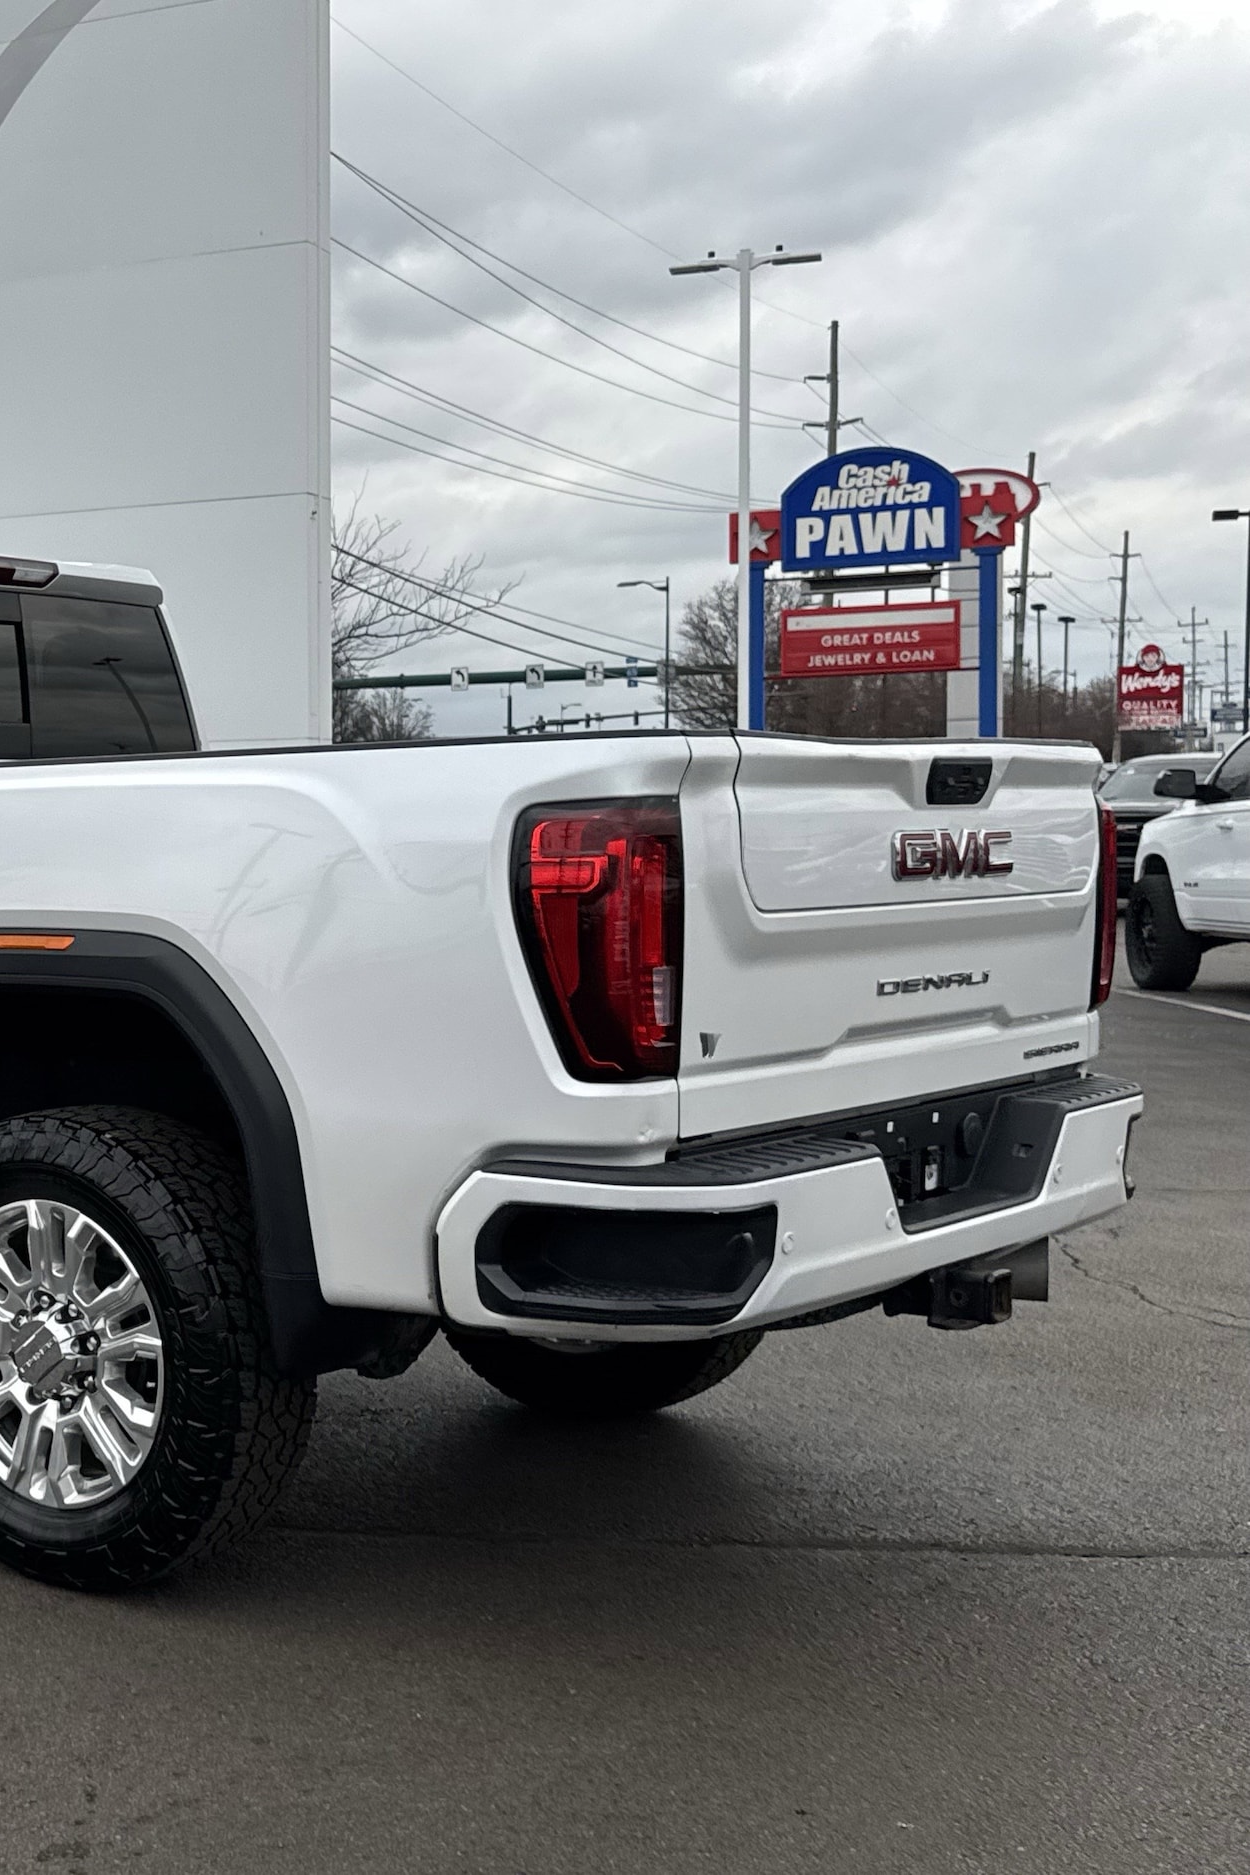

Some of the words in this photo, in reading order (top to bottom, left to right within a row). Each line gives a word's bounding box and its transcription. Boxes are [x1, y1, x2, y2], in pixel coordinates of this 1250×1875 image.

[838, 460, 909, 489] Cash
[811, 481, 931, 512] America
[795, 507, 945, 559] PAWN
[821, 633, 869, 648] GREAT
[873, 630, 920, 645] DEALS
[808, 652, 871, 668] JEWELRY
[876, 653, 886, 664] &
[892, 649, 935, 663] LOAN
[1121, 669, 1180, 694] Wendy's
[1122, 700, 1178, 711] QUALITY
[891, 828, 1014, 881] GMC
[876, 969, 991, 997] DENALI
